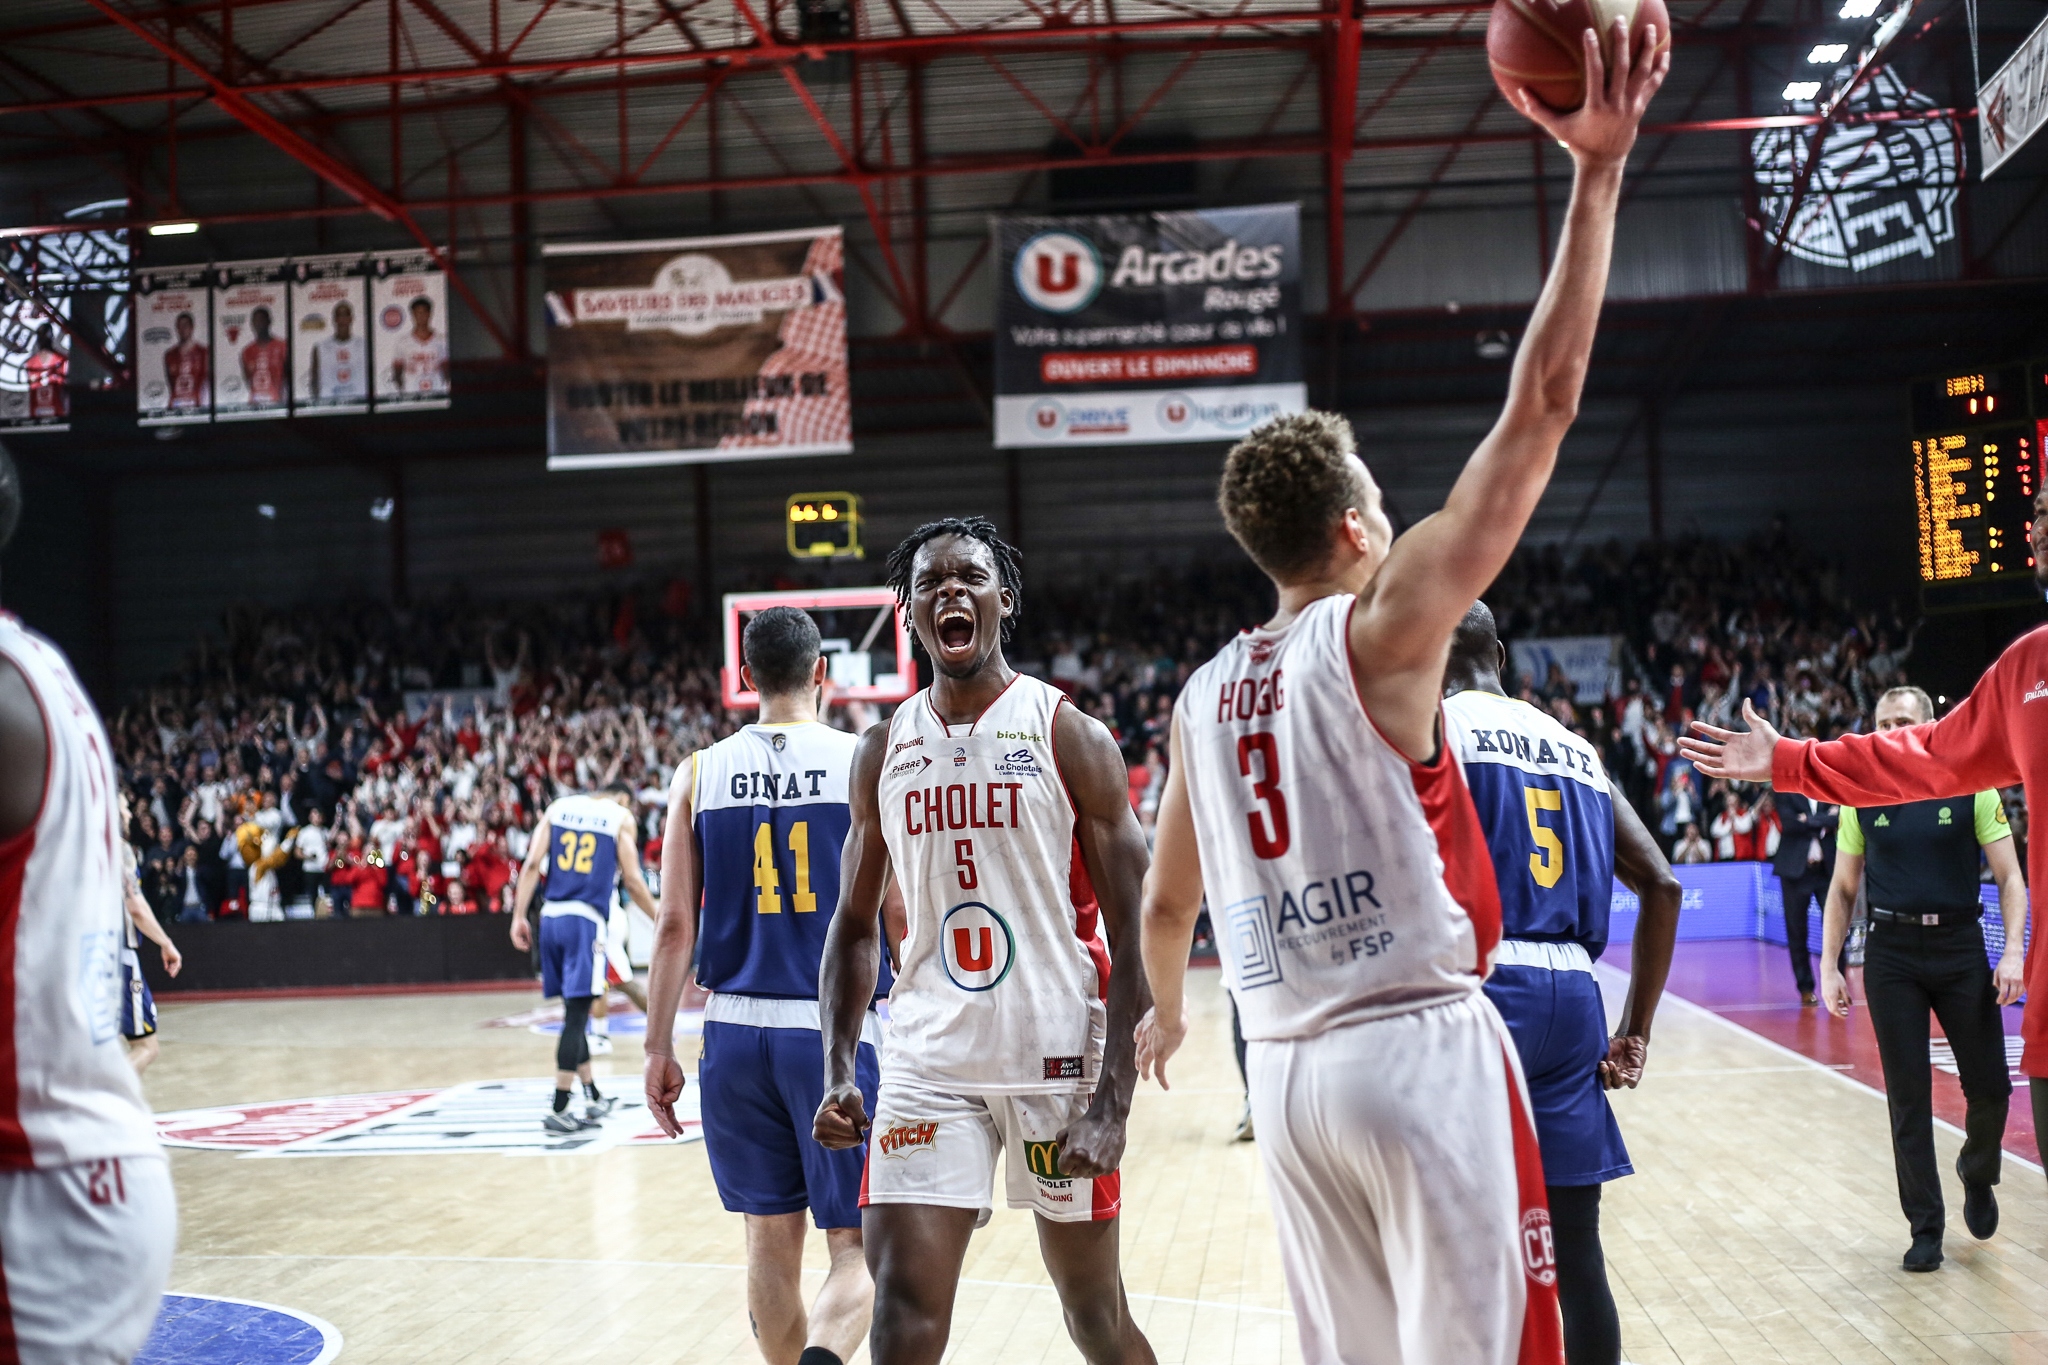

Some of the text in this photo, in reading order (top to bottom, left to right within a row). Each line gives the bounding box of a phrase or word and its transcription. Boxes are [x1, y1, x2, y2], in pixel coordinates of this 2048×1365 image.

[1037, 253, 1079, 294] U
[1110, 239, 1284, 288] Arcades
[1044, 350, 1253, 380] OUVERT LE DIMANCHE
[1217, 668, 1285, 724] HOGG
[2023, 687, 2048, 704] SPALDIN
[894, 735, 924, 755] SPALDING
[1471, 729, 1594, 778] KONATE
[731, 769, 827, 801] GINAT
[1006, 763, 1043, 773] Choletais
[904, 782, 1023, 836] CHOLET
[1237, 731, 1291, 860] 3
[556, 830, 598, 875] 32
[1523, 785, 1564, 889] 5
[753, 821, 818, 915] 41
[954, 838, 979, 890] 5
[1277, 869, 1383, 935] AGIR
[953, 927, 994, 973] U
[1279, 913, 1386, 950] RECOUVREMENT
[1348, 931, 1395, 961] FSP
[1036, 1176, 1073, 1189] CHOLET
[1040, 1188, 1073, 1203] SPALDING
